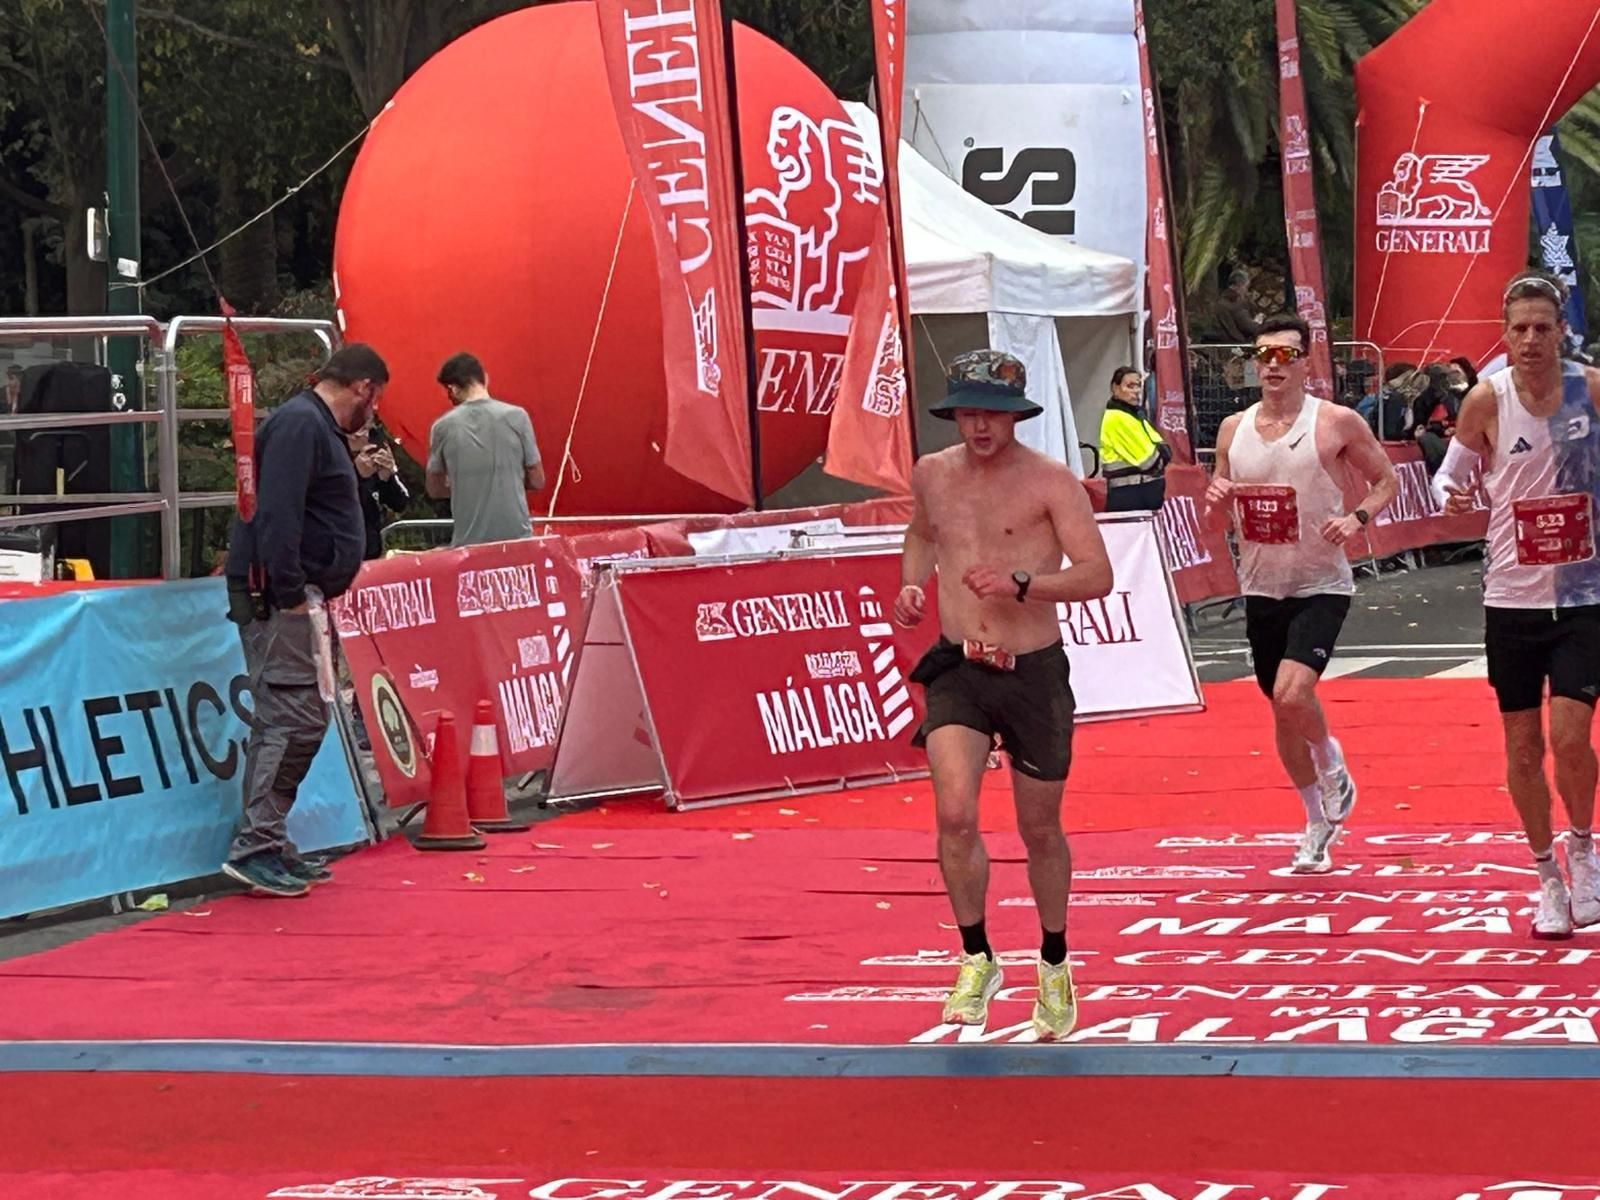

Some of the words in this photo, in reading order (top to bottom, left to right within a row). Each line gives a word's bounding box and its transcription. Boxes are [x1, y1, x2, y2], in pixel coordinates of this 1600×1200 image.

[1375, 229, 1491, 253] GENERALI
[357, 577, 436, 636] GENERALI
[477, 563, 541, 613] GENERALI
[731, 590, 851, 638] GENERALI
[756, 676, 886, 755] MÁLAGA
